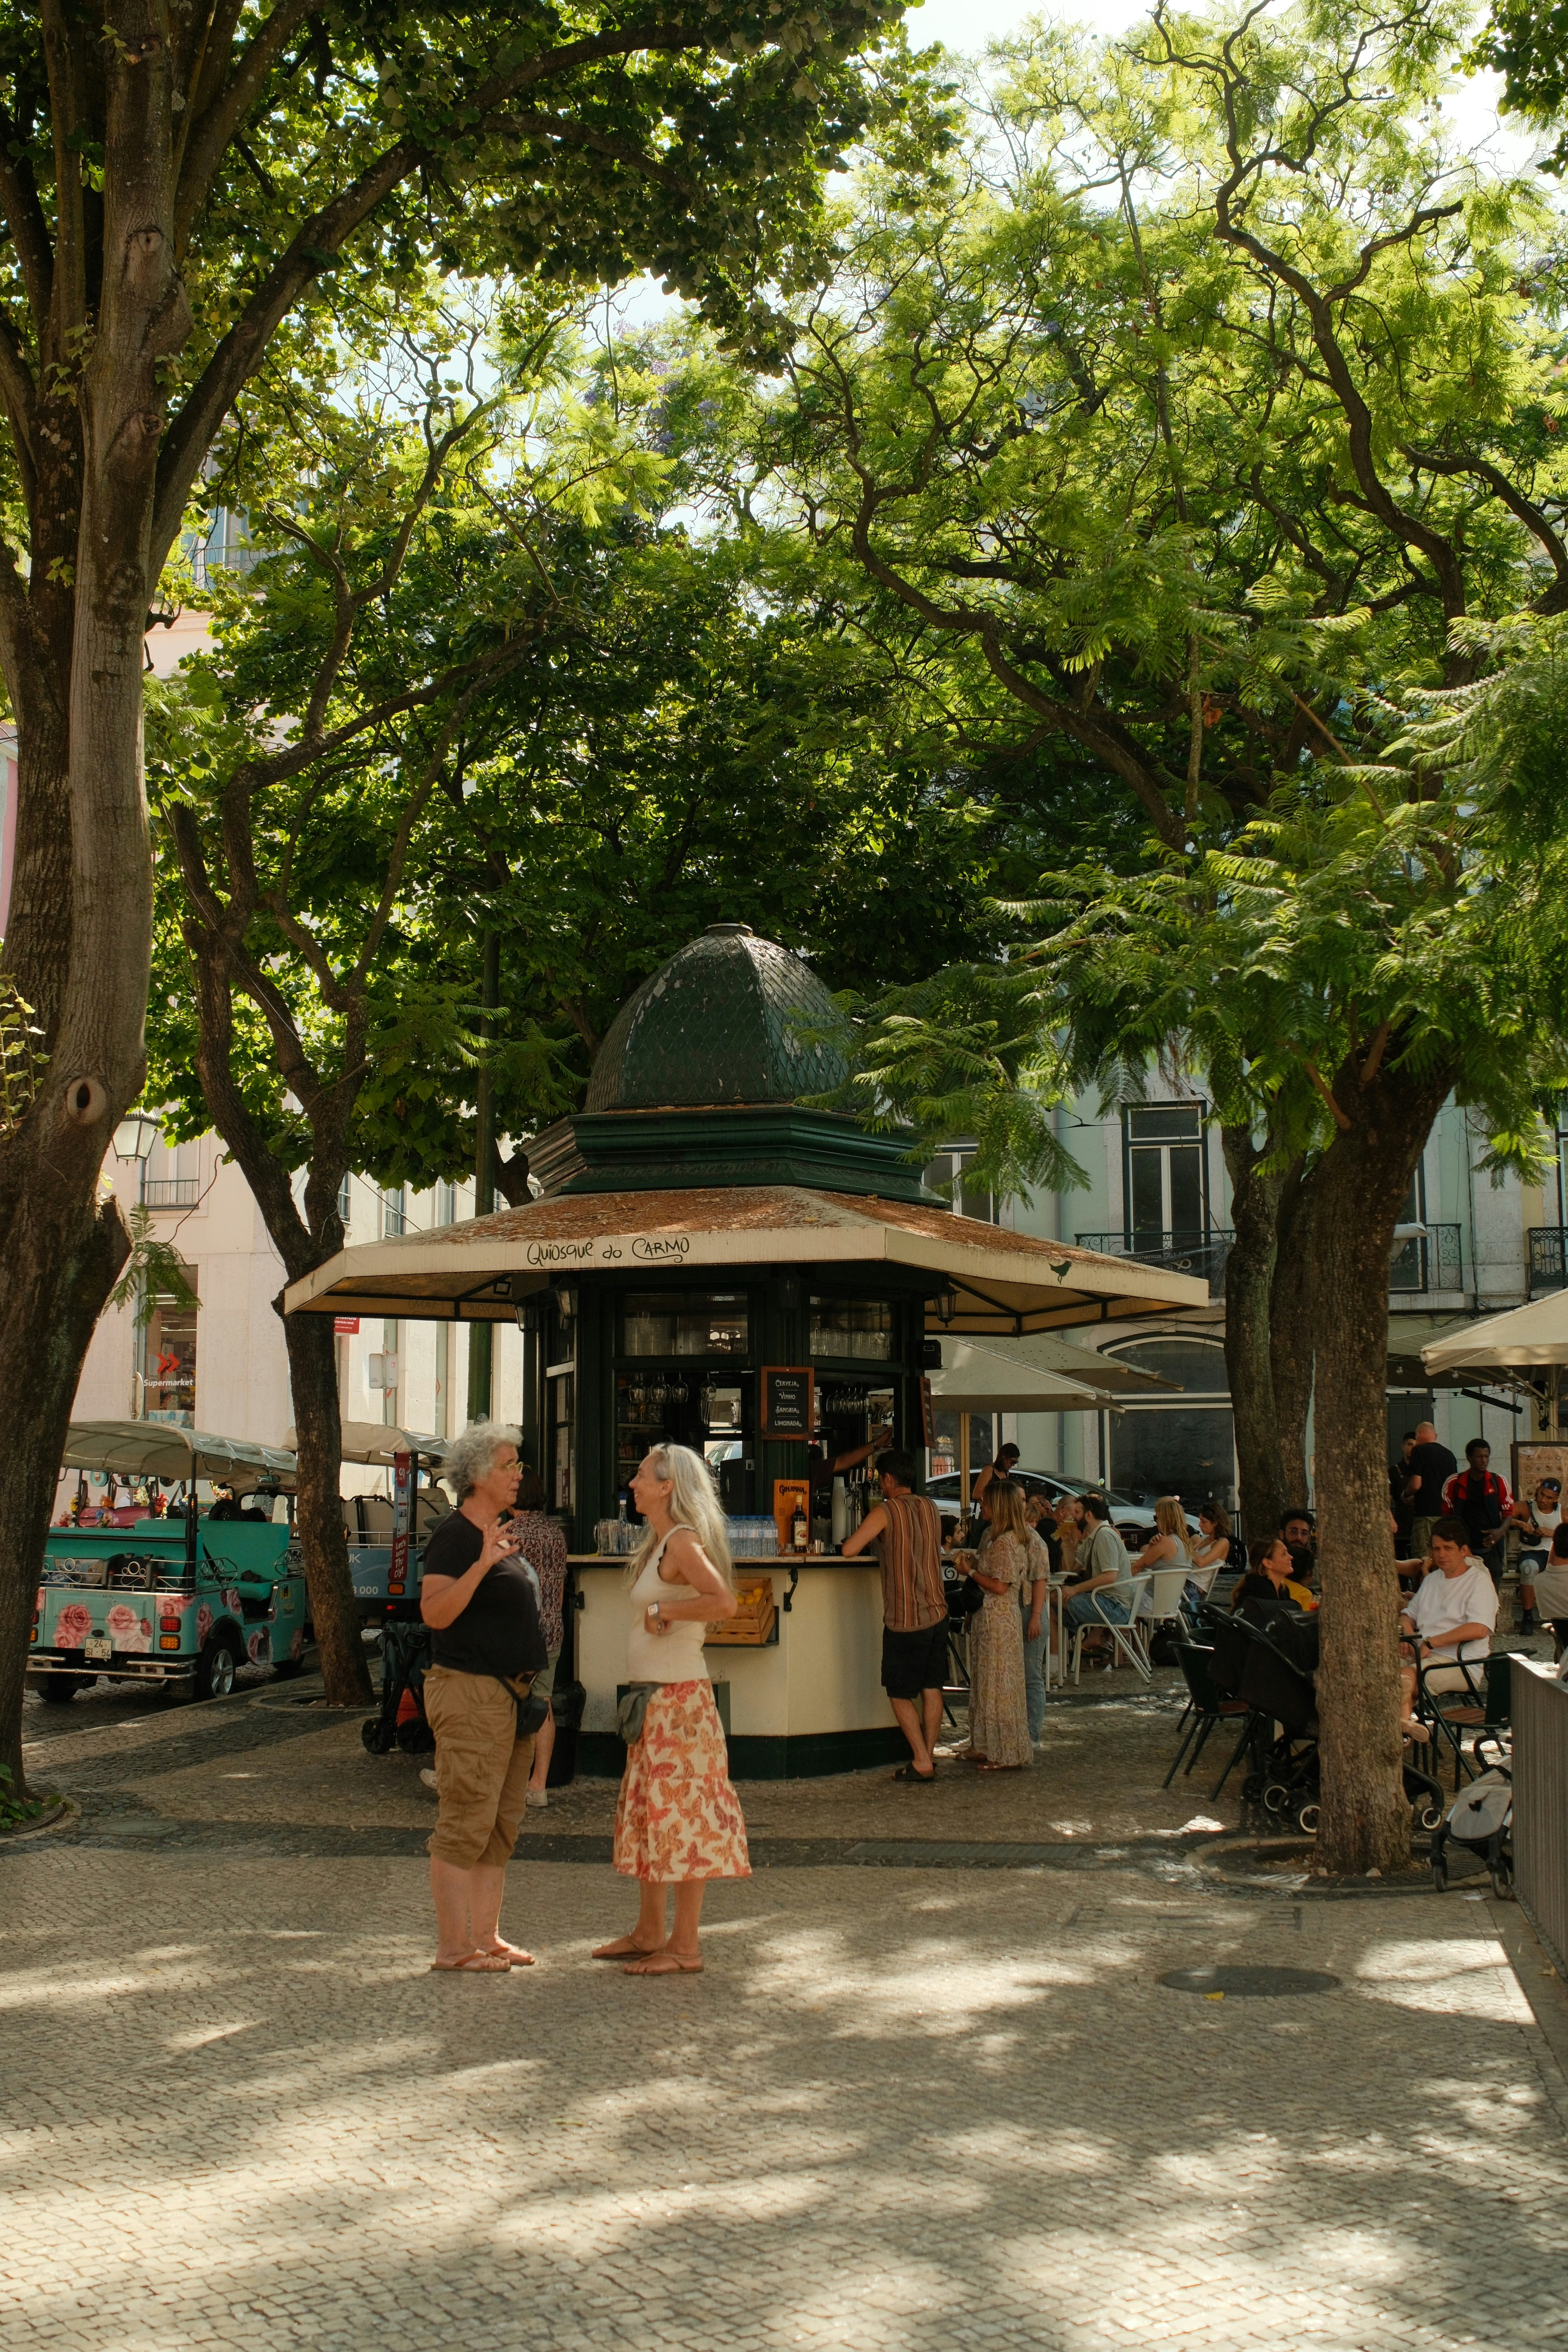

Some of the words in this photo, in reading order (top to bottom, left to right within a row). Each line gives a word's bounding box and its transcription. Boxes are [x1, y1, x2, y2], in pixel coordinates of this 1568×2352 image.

[527, 1242, 594, 1266] Quiosque
[602, 1245, 622, 1260] do
[632, 1237, 689, 1263] CARMO
[144, 1378, 193, 1388] Supermarket
[779, 1391, 796, 1400] VINHO
[779, 1485, 807, 1496] GINJINHA
[396, 1539, 406, 1550] Let's
[359, 1586, 378, 1594] 000
[94, 1639, 103, 1648] 24
[101, 1648, 110, 1657] 54
